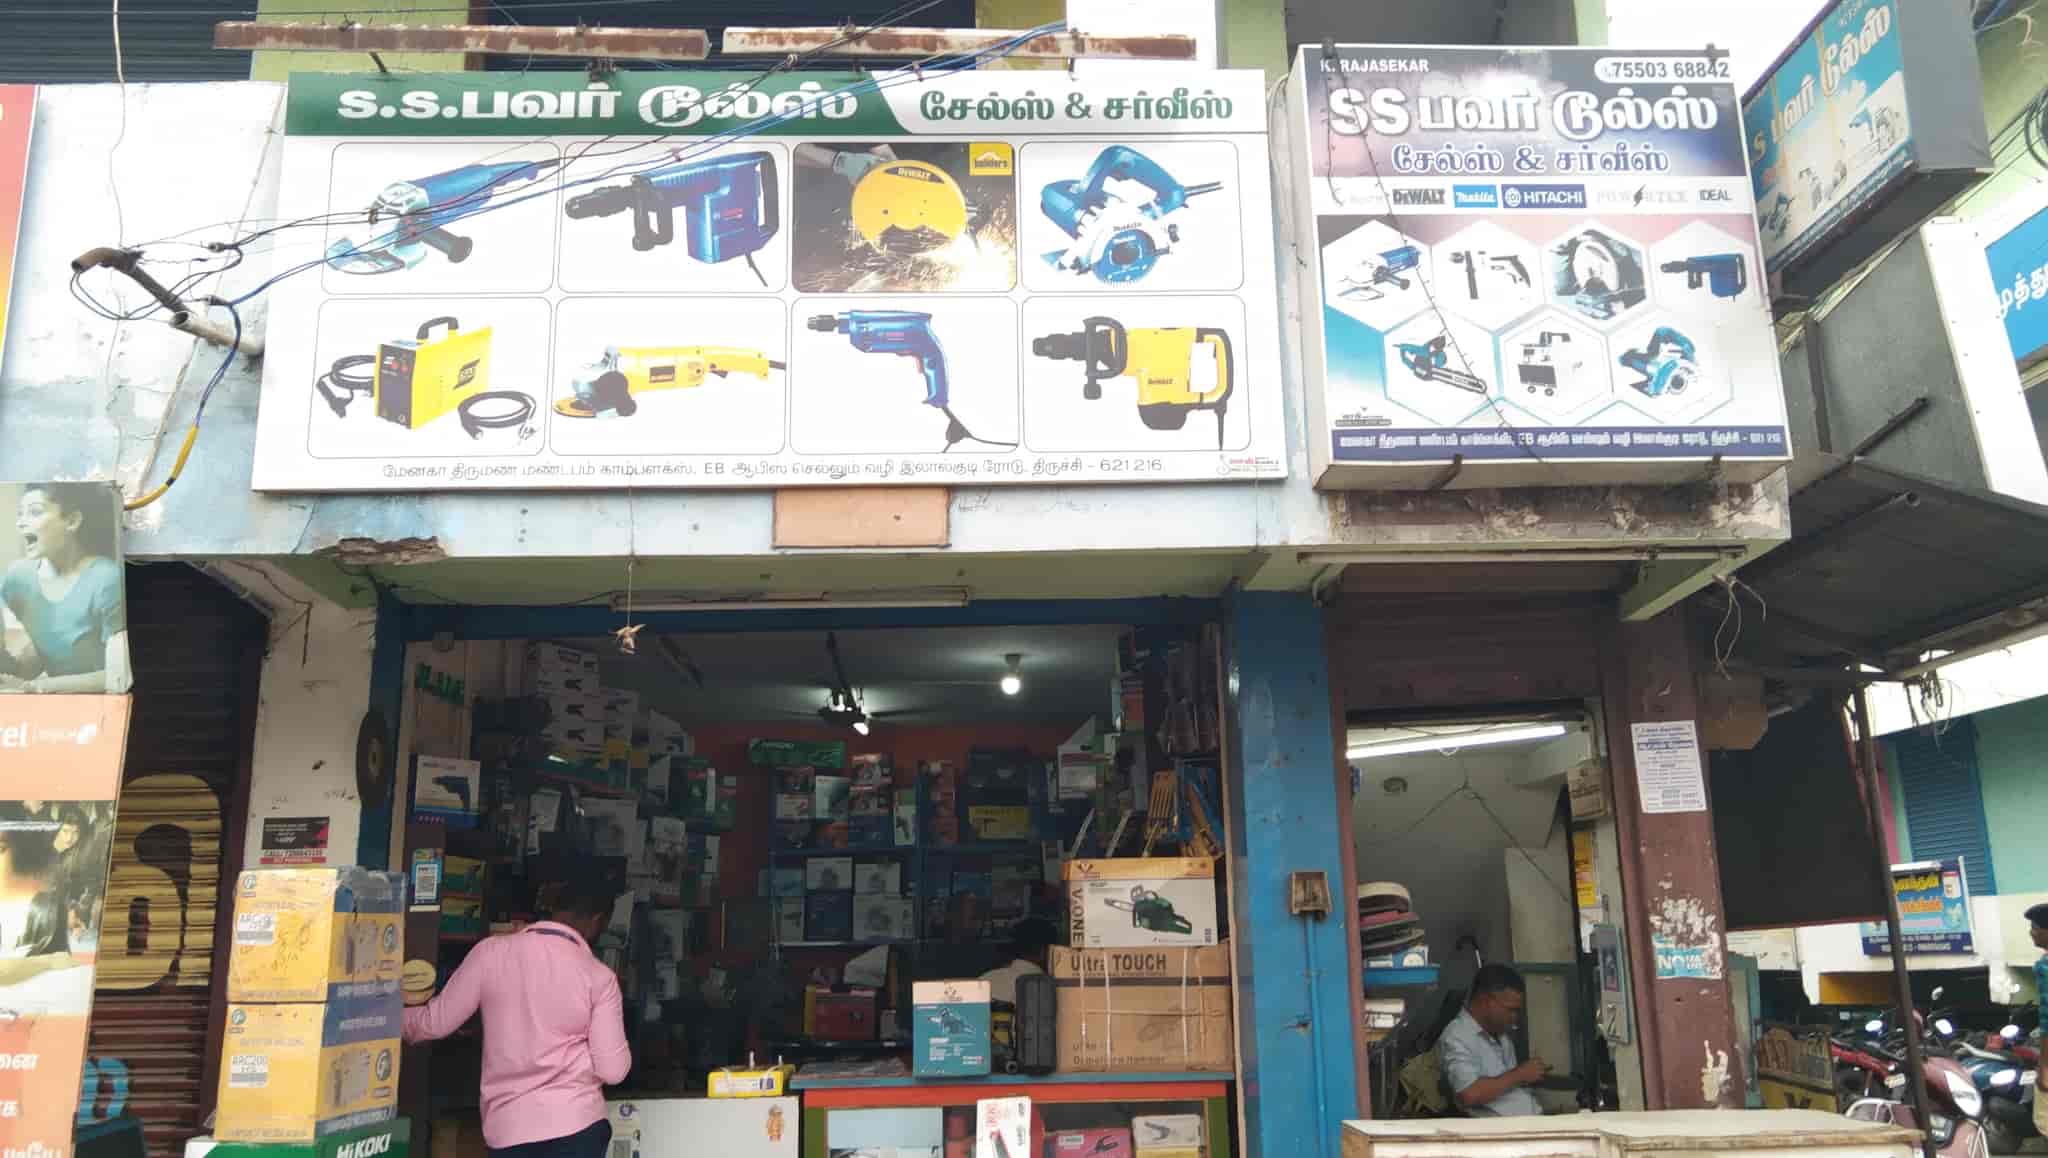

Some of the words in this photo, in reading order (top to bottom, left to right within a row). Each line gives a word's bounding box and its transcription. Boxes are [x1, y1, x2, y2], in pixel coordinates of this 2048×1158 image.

[1340, 58, 1430, 73] RAJASEKAR
[1612, 61, 1668, 79] 75503
[1673, 61, 1730, 79] 68842
[638, 80, 858, 128] டூல்ஸ்
[919, 90, 1055, 121] சேல்ஸ்
[1064, 91, 1093, 120] &
[1102, 86, 1234, 120] சர்வீஸ்
[1418, 86, 1539, 131] பவர்
[1552, 85, 1719, 141] டூல்ஸ்
[1392, 143, 1505, 173] சேல்ஸ்
[1514, 145, 1546, 173] &
[1555, 142, 1670, 173] சர்வீஸ்
[1523, 190, 1584, 203] HITACHI
[1699, 188, 1733, 202] IDEAL
[703, 461, 725, 474] EB
[1100, 458, 1130, 473] 621
[1133, 458, 1163, 473] 216
[1112, 954, 1167, 971] TOUCH
[335, 1132, 392, 1158] HiKOKI
